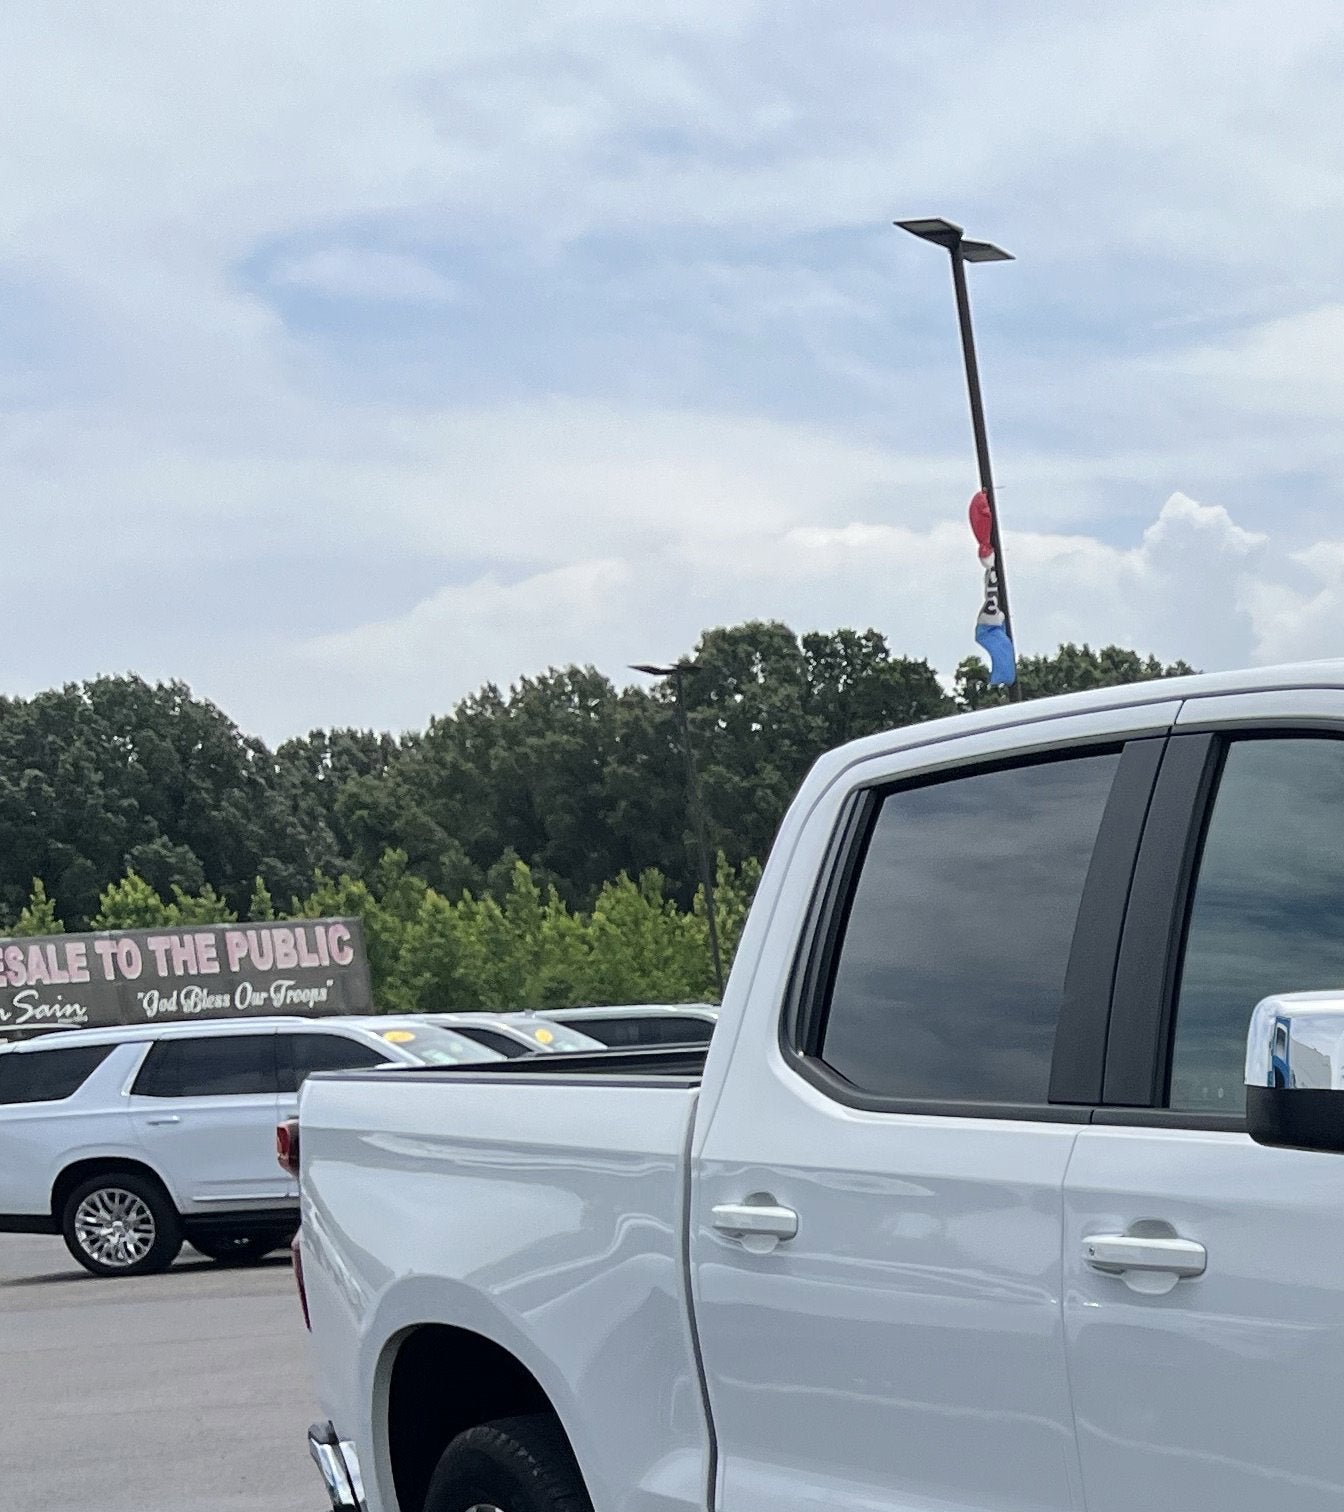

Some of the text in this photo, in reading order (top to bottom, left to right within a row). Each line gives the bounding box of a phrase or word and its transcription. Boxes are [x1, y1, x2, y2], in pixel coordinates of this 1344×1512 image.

[0, 923, 355, 988] SALE TO THE PUBLIC
[13, 989, 88, 1024] Sain
[180, 985, 231, 1014] Bless
[234, 981, 268, 1010] Our
